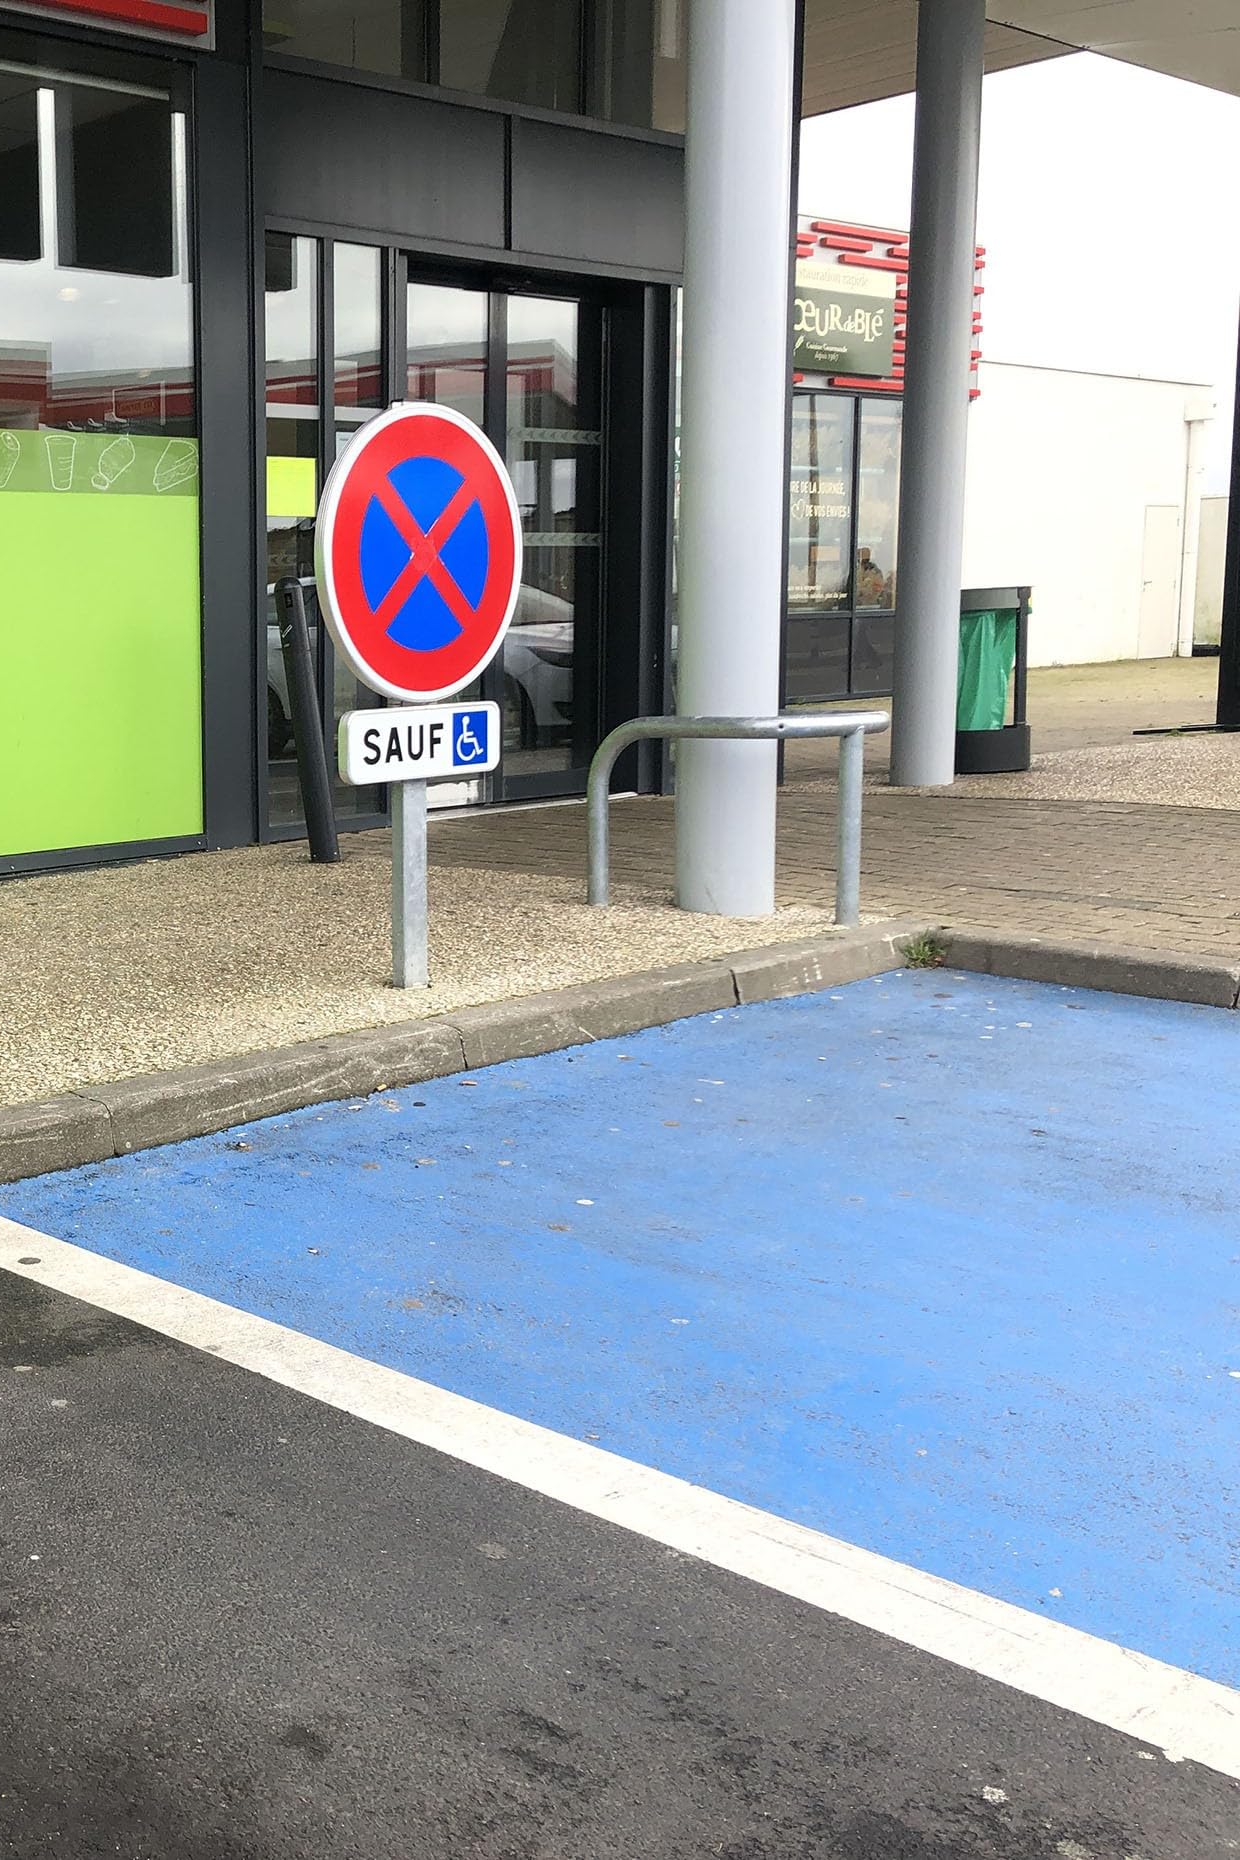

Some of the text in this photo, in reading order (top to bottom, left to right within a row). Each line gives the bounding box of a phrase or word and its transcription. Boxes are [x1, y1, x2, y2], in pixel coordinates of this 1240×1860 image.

[794, 298, 843, 337] ŒUR
[809, 481, 817, 493] LA
[805, 505, 813, 517] DE
[814, 505, 826, 517] VOS
[363, 722, 444, 766] SAUF
